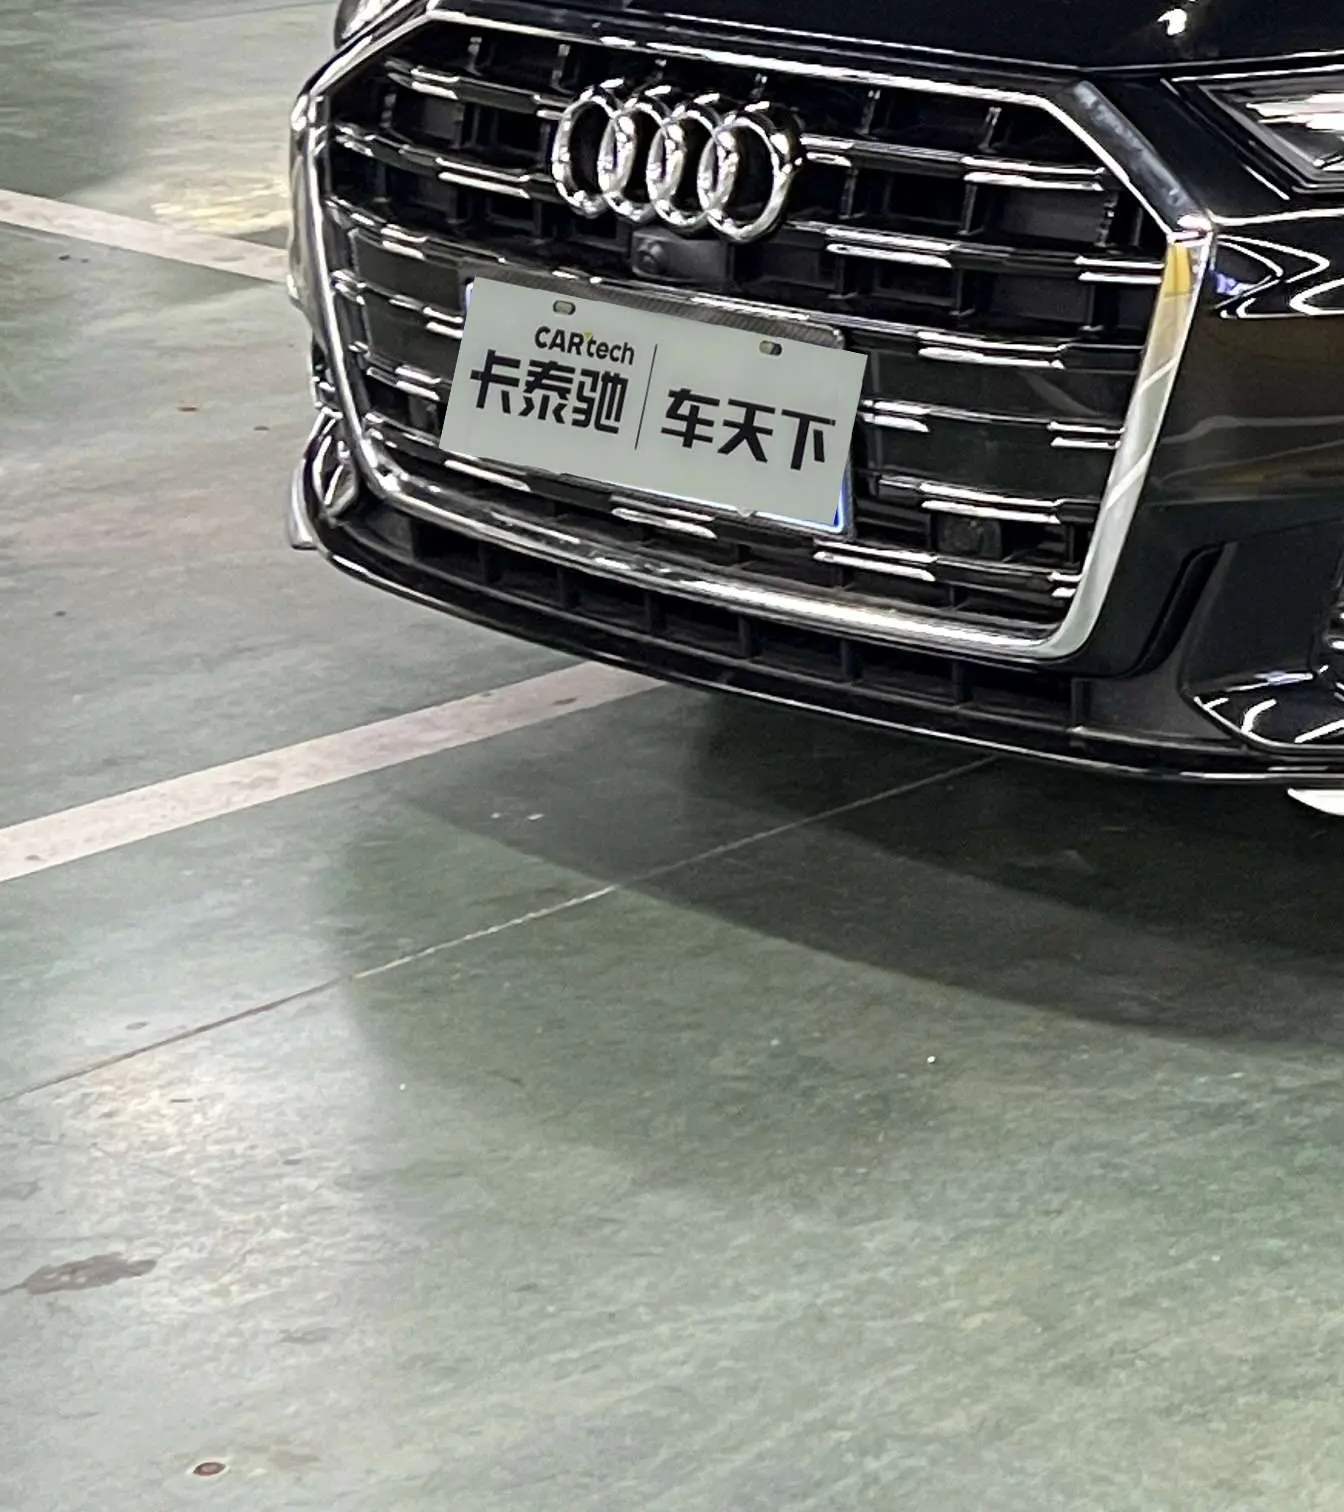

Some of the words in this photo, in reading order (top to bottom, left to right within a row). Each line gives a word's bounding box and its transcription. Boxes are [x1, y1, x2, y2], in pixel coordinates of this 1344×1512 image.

[534, 325, 636, 367] CARtech
[469, 348, 630, 436] 卡泰驰
[660, 387, 837, 472] 车天下
